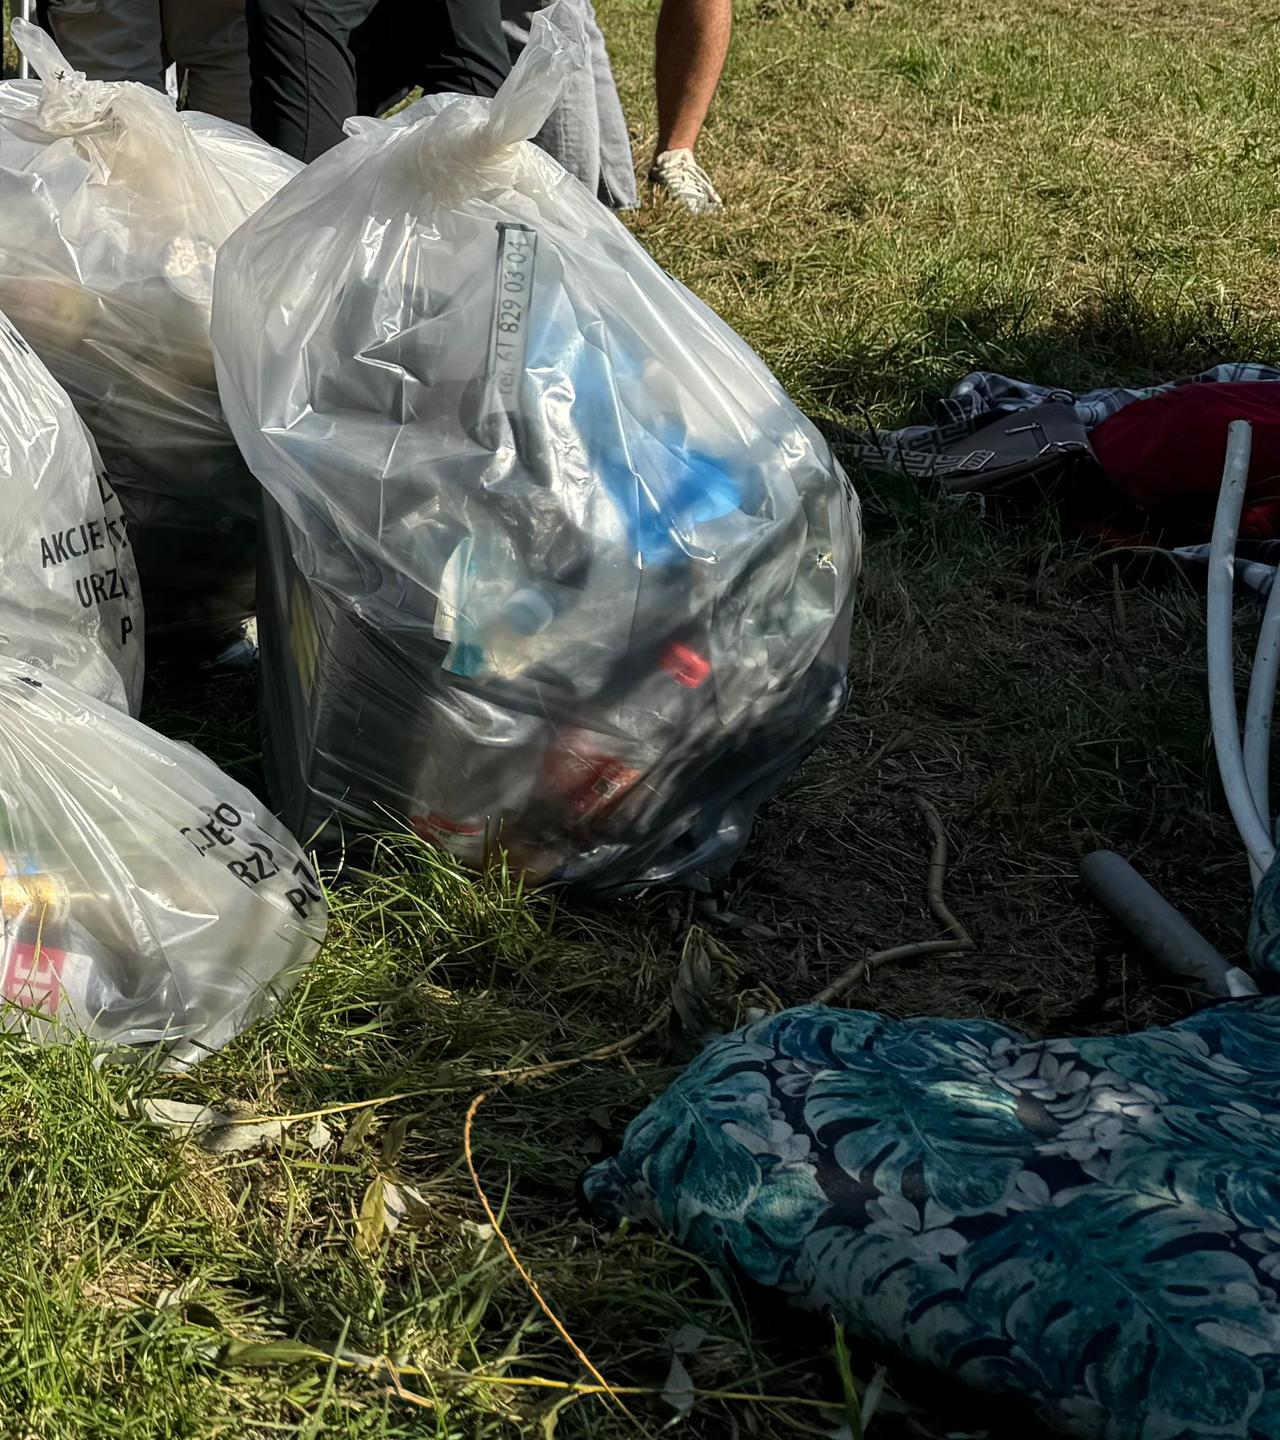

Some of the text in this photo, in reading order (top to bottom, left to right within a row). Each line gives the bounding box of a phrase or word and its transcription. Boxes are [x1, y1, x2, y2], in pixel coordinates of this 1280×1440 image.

[504, 270, 525, 294] 03
[500, 299, 523, 333] 829
[40, 520, 105, 569] AKCJE
